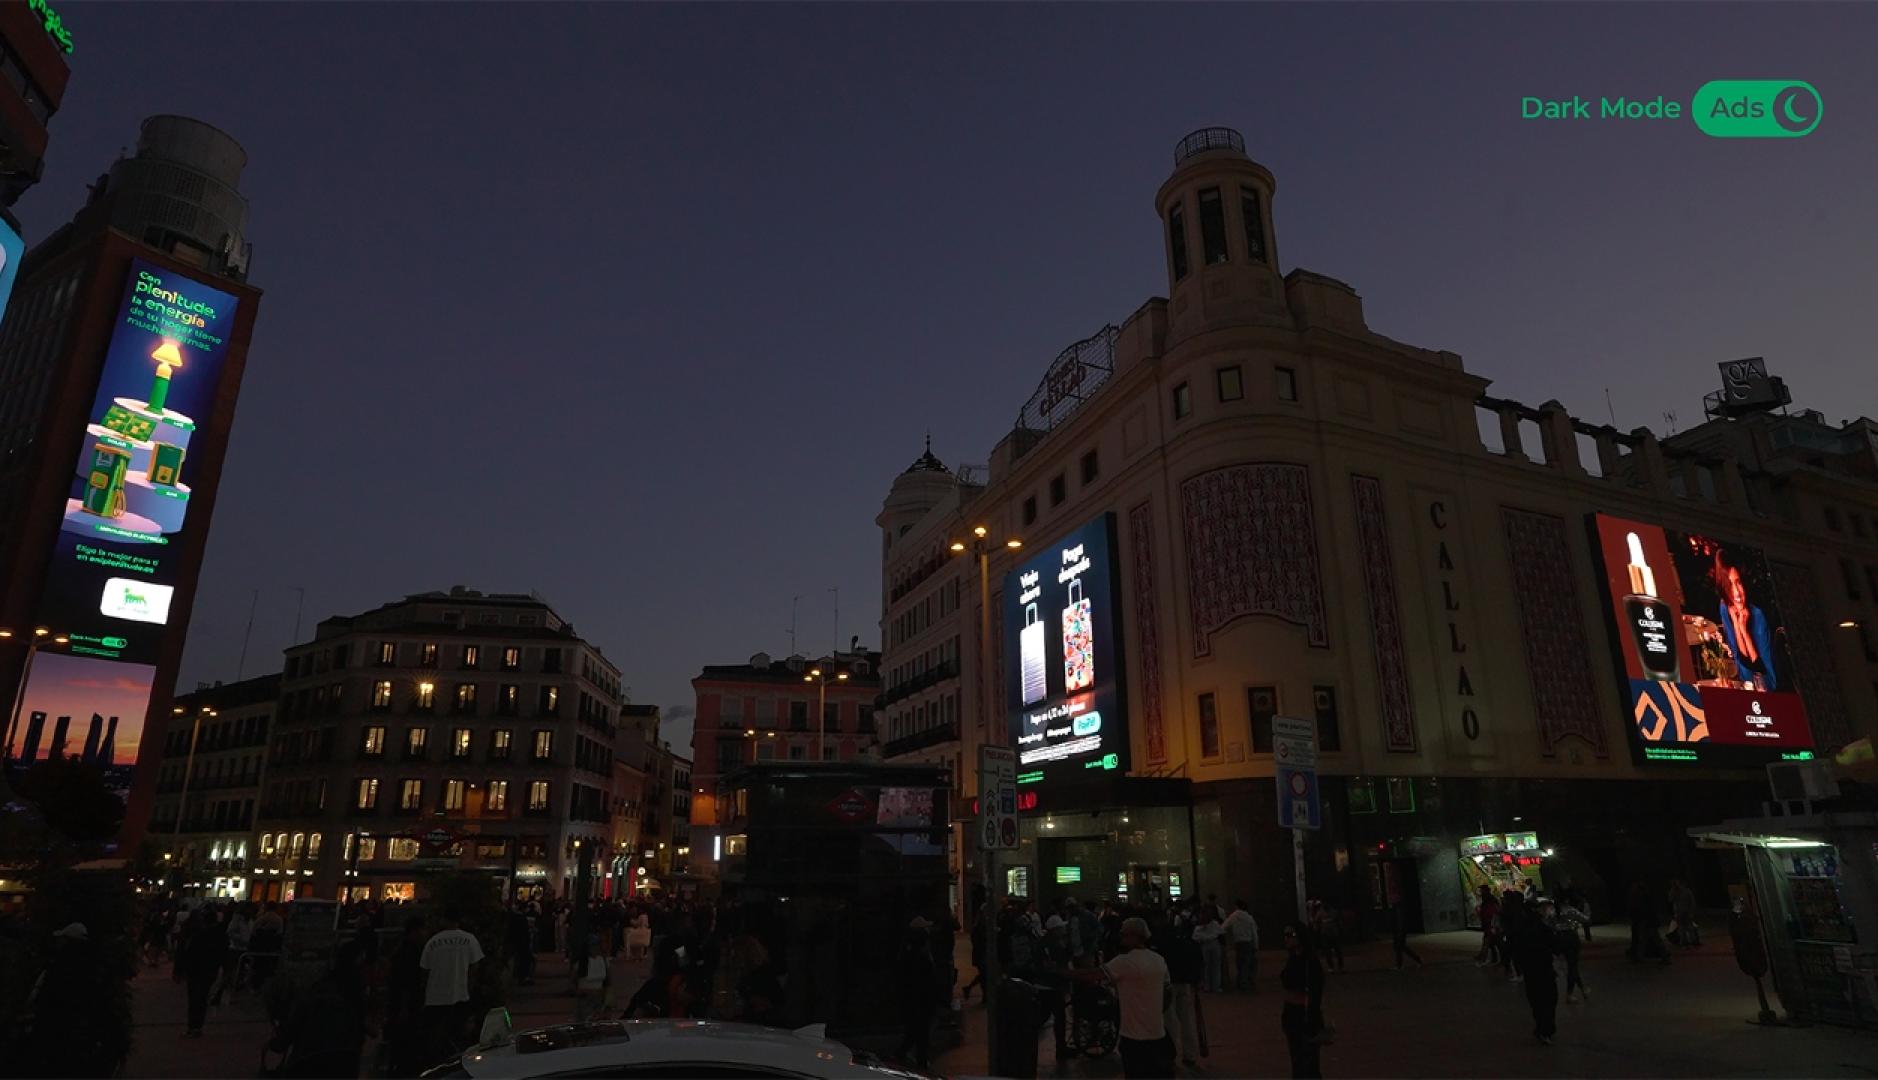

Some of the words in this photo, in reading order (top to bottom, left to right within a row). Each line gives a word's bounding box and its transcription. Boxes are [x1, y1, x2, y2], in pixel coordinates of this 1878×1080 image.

[139, 271, 161, 285] Con
[131, 295, 142, 305] la
[1430, 501, 1480, 741] CALLAO
